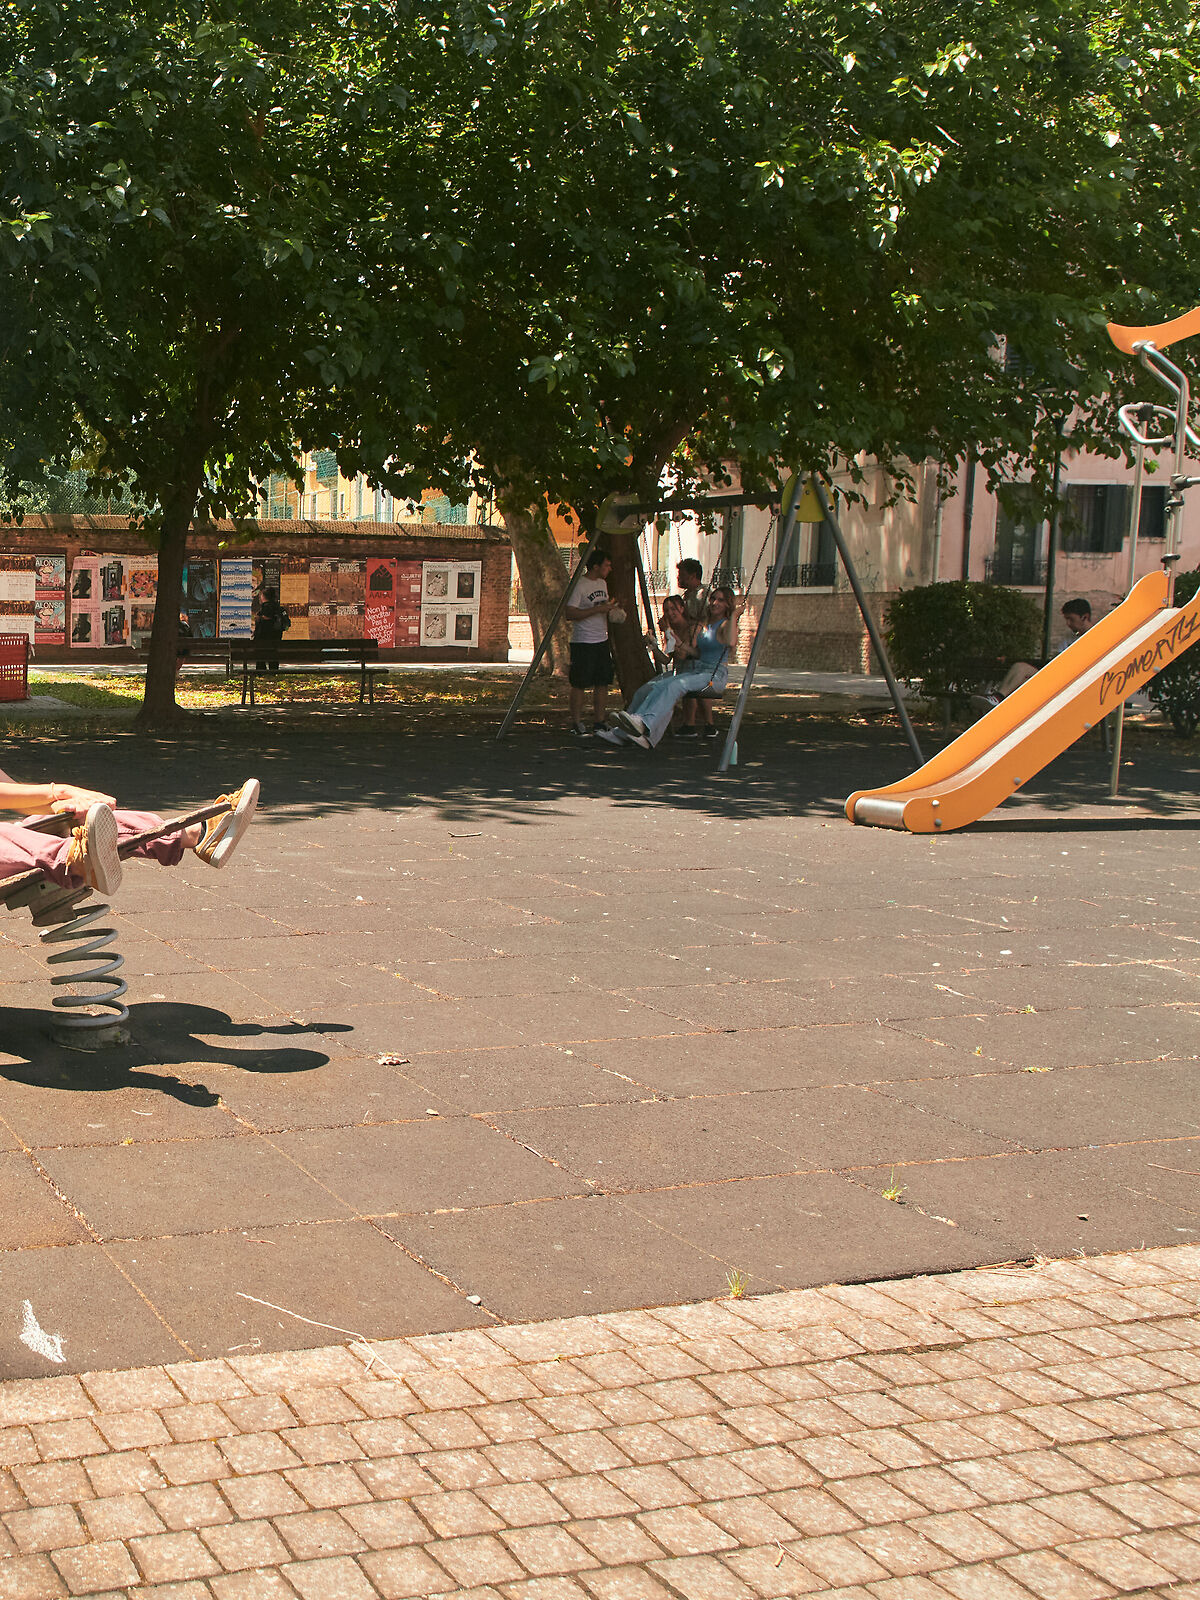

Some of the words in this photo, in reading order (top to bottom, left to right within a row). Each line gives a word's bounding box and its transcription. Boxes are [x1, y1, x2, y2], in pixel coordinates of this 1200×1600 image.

[35, 559, 64, 567] ALONSO
[35, 601, 64, 609] ALONSO
[367, 606, 380, 615] Non
[371, 619, 382, 627] Pas
